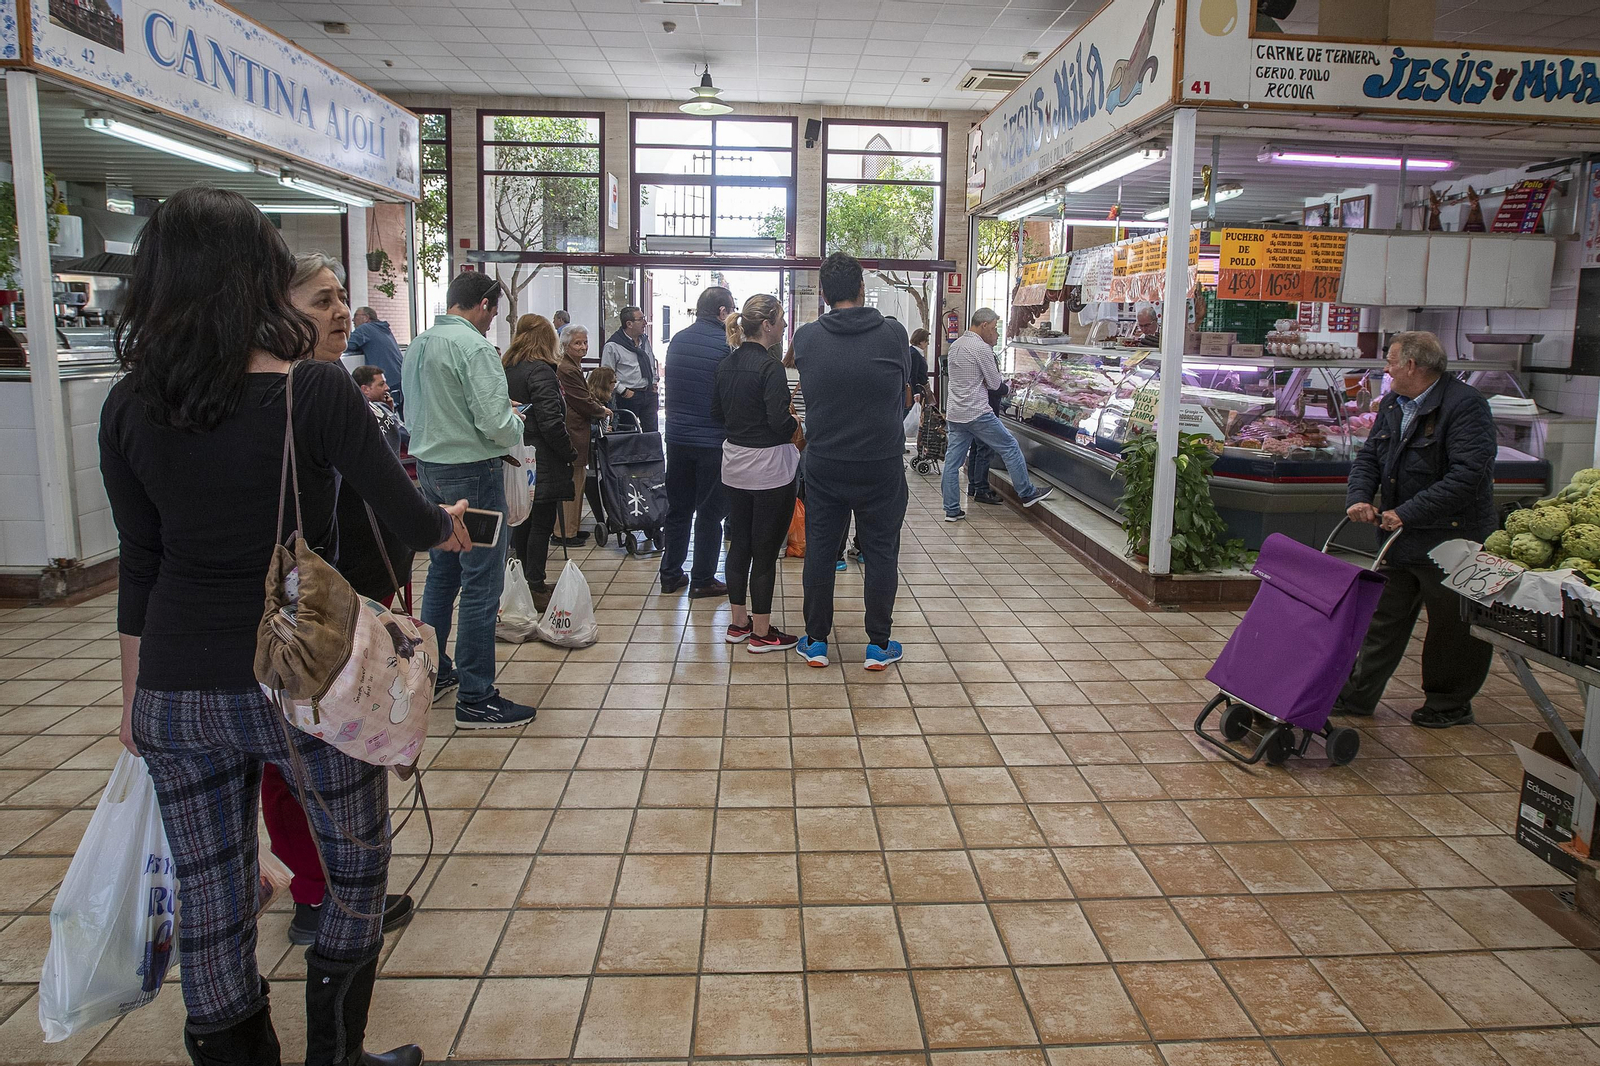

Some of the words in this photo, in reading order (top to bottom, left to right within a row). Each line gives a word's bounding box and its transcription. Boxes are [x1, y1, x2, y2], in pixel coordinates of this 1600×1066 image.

[81, 47, 96, 65] 42
[1256, 45, 1304, 61] CARNE
[1307, 48, 1323, 62] DE
[1299, 69, 1330, 82] POLLO
[144, 12, 316, 130] CANTINA
[326, 100, 386, 159] AJOLÍ
[1191, 81, 1211, 94] 41
[1523, 180, 1544, 189] Pollo
[1225, 232, 1265, 242] PUCHERO
[1238, 245, 1250, 254] DE
[1230, 257, 1256, 266] POLLO
[1130, 410, 1155, 422] CAMPO
[1526, 780, 1562, 806] Eduardo
